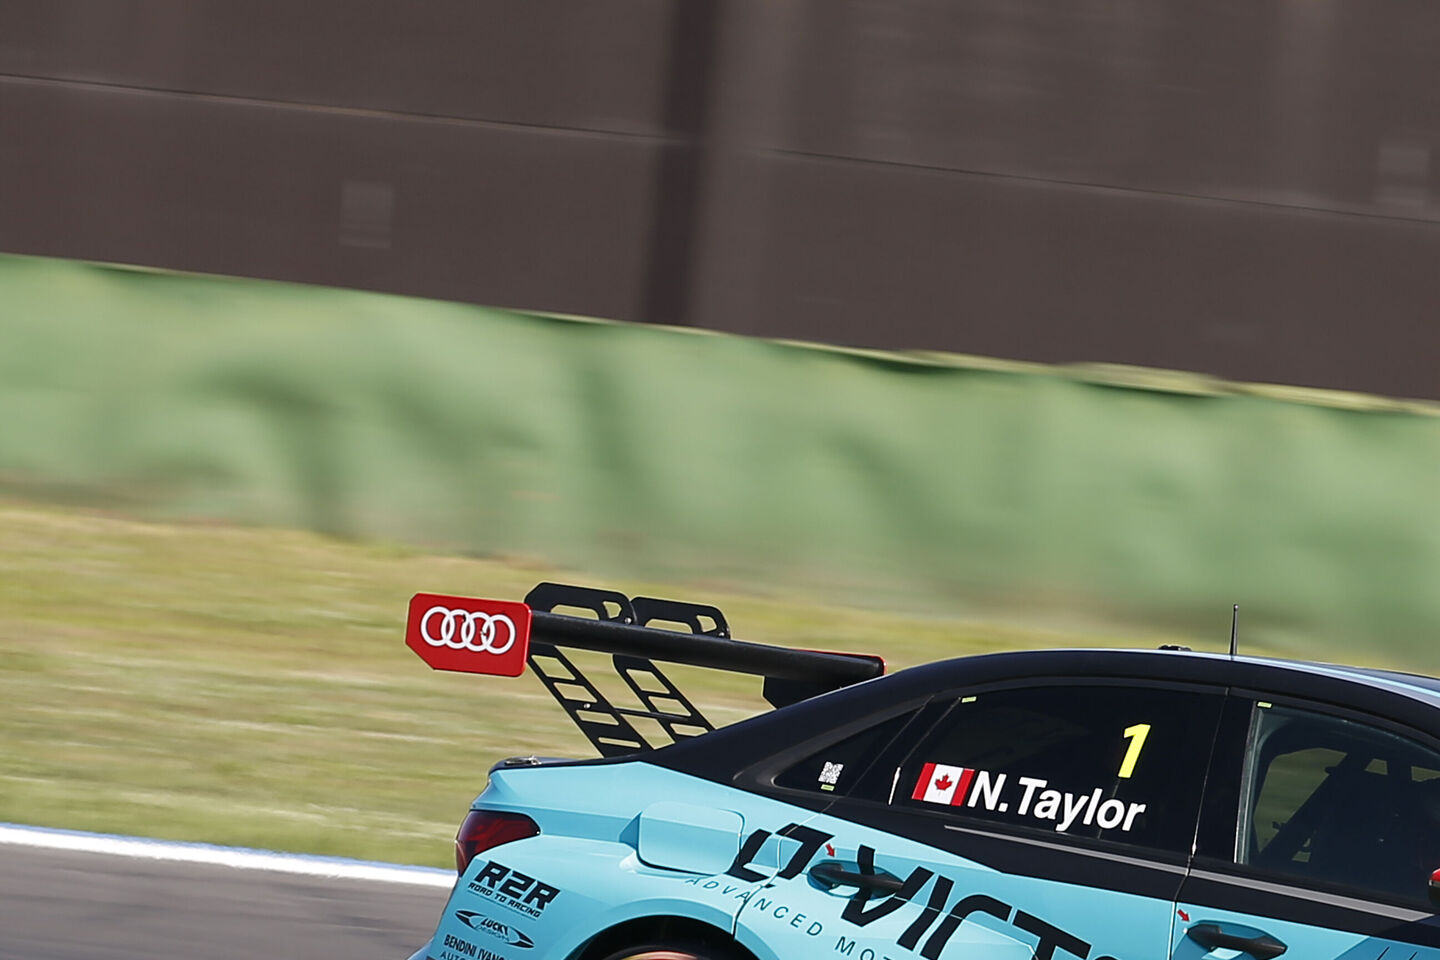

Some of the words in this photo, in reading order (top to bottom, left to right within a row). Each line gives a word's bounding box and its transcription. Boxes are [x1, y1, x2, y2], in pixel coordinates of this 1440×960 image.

[1117, 723, 1151, 779] 1
[468, 881, 493, 897] ROAD
[494, 893, 507, 903] TO
[507, 898, 542, 919] RACING
[473, 860, 561, 911] R2R
[686, 875, 823, 938] ADVANCED
[443, 934, 478, 957] BENDINI
[480, 917, 509, 936] LUCKY
